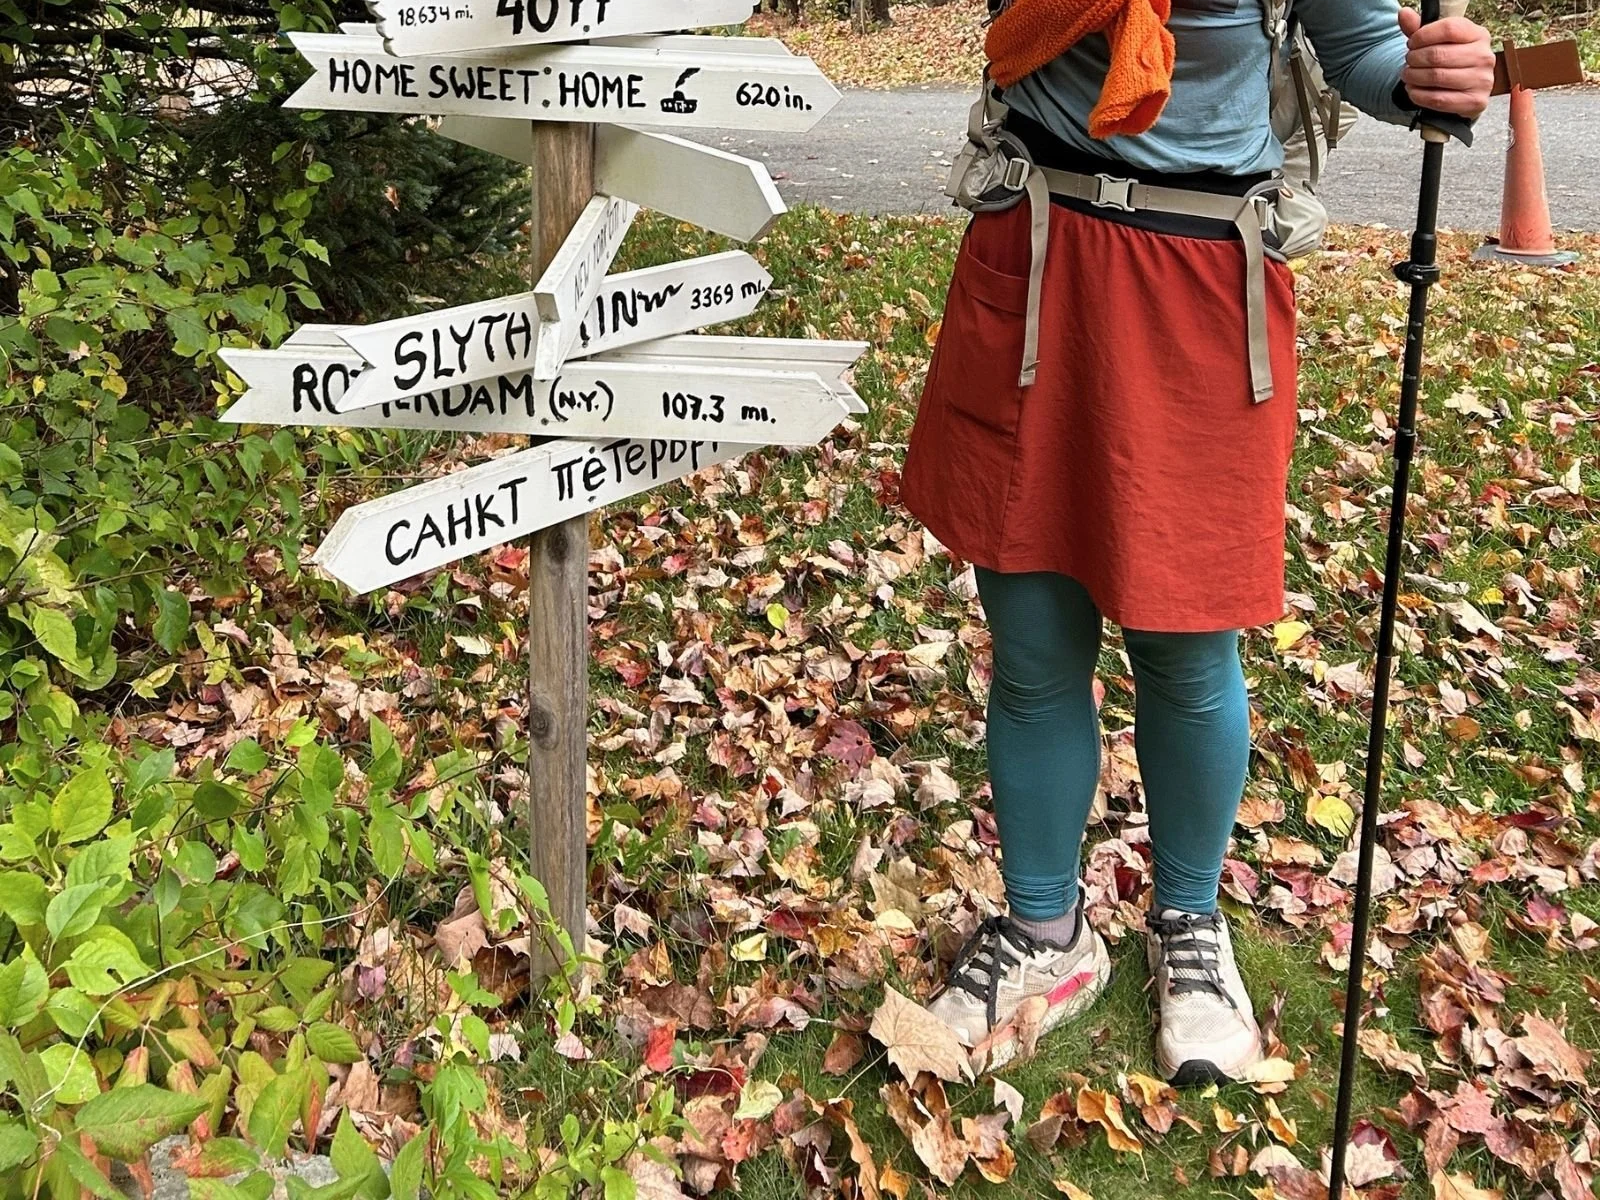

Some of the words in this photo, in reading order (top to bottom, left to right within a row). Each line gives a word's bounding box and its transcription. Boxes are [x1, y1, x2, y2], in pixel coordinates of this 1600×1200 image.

[455, 5, 473, 20] mi.
[329, 58, 419, 98] HOME
[428, 65, 540, 105] SWEET
[559, 71, 646, 108] HOME
[735, 82, 780, 107] 620
[784, 85, 812, 111] in.
[690, 283, 733, 310] 3369
[549, 375, 614, 422] (N.Y.)
[662, 392, 725, 423] 107.3
[741, 405, 776, 424] mi.
[384, 477, 527, 566] САНКТ
